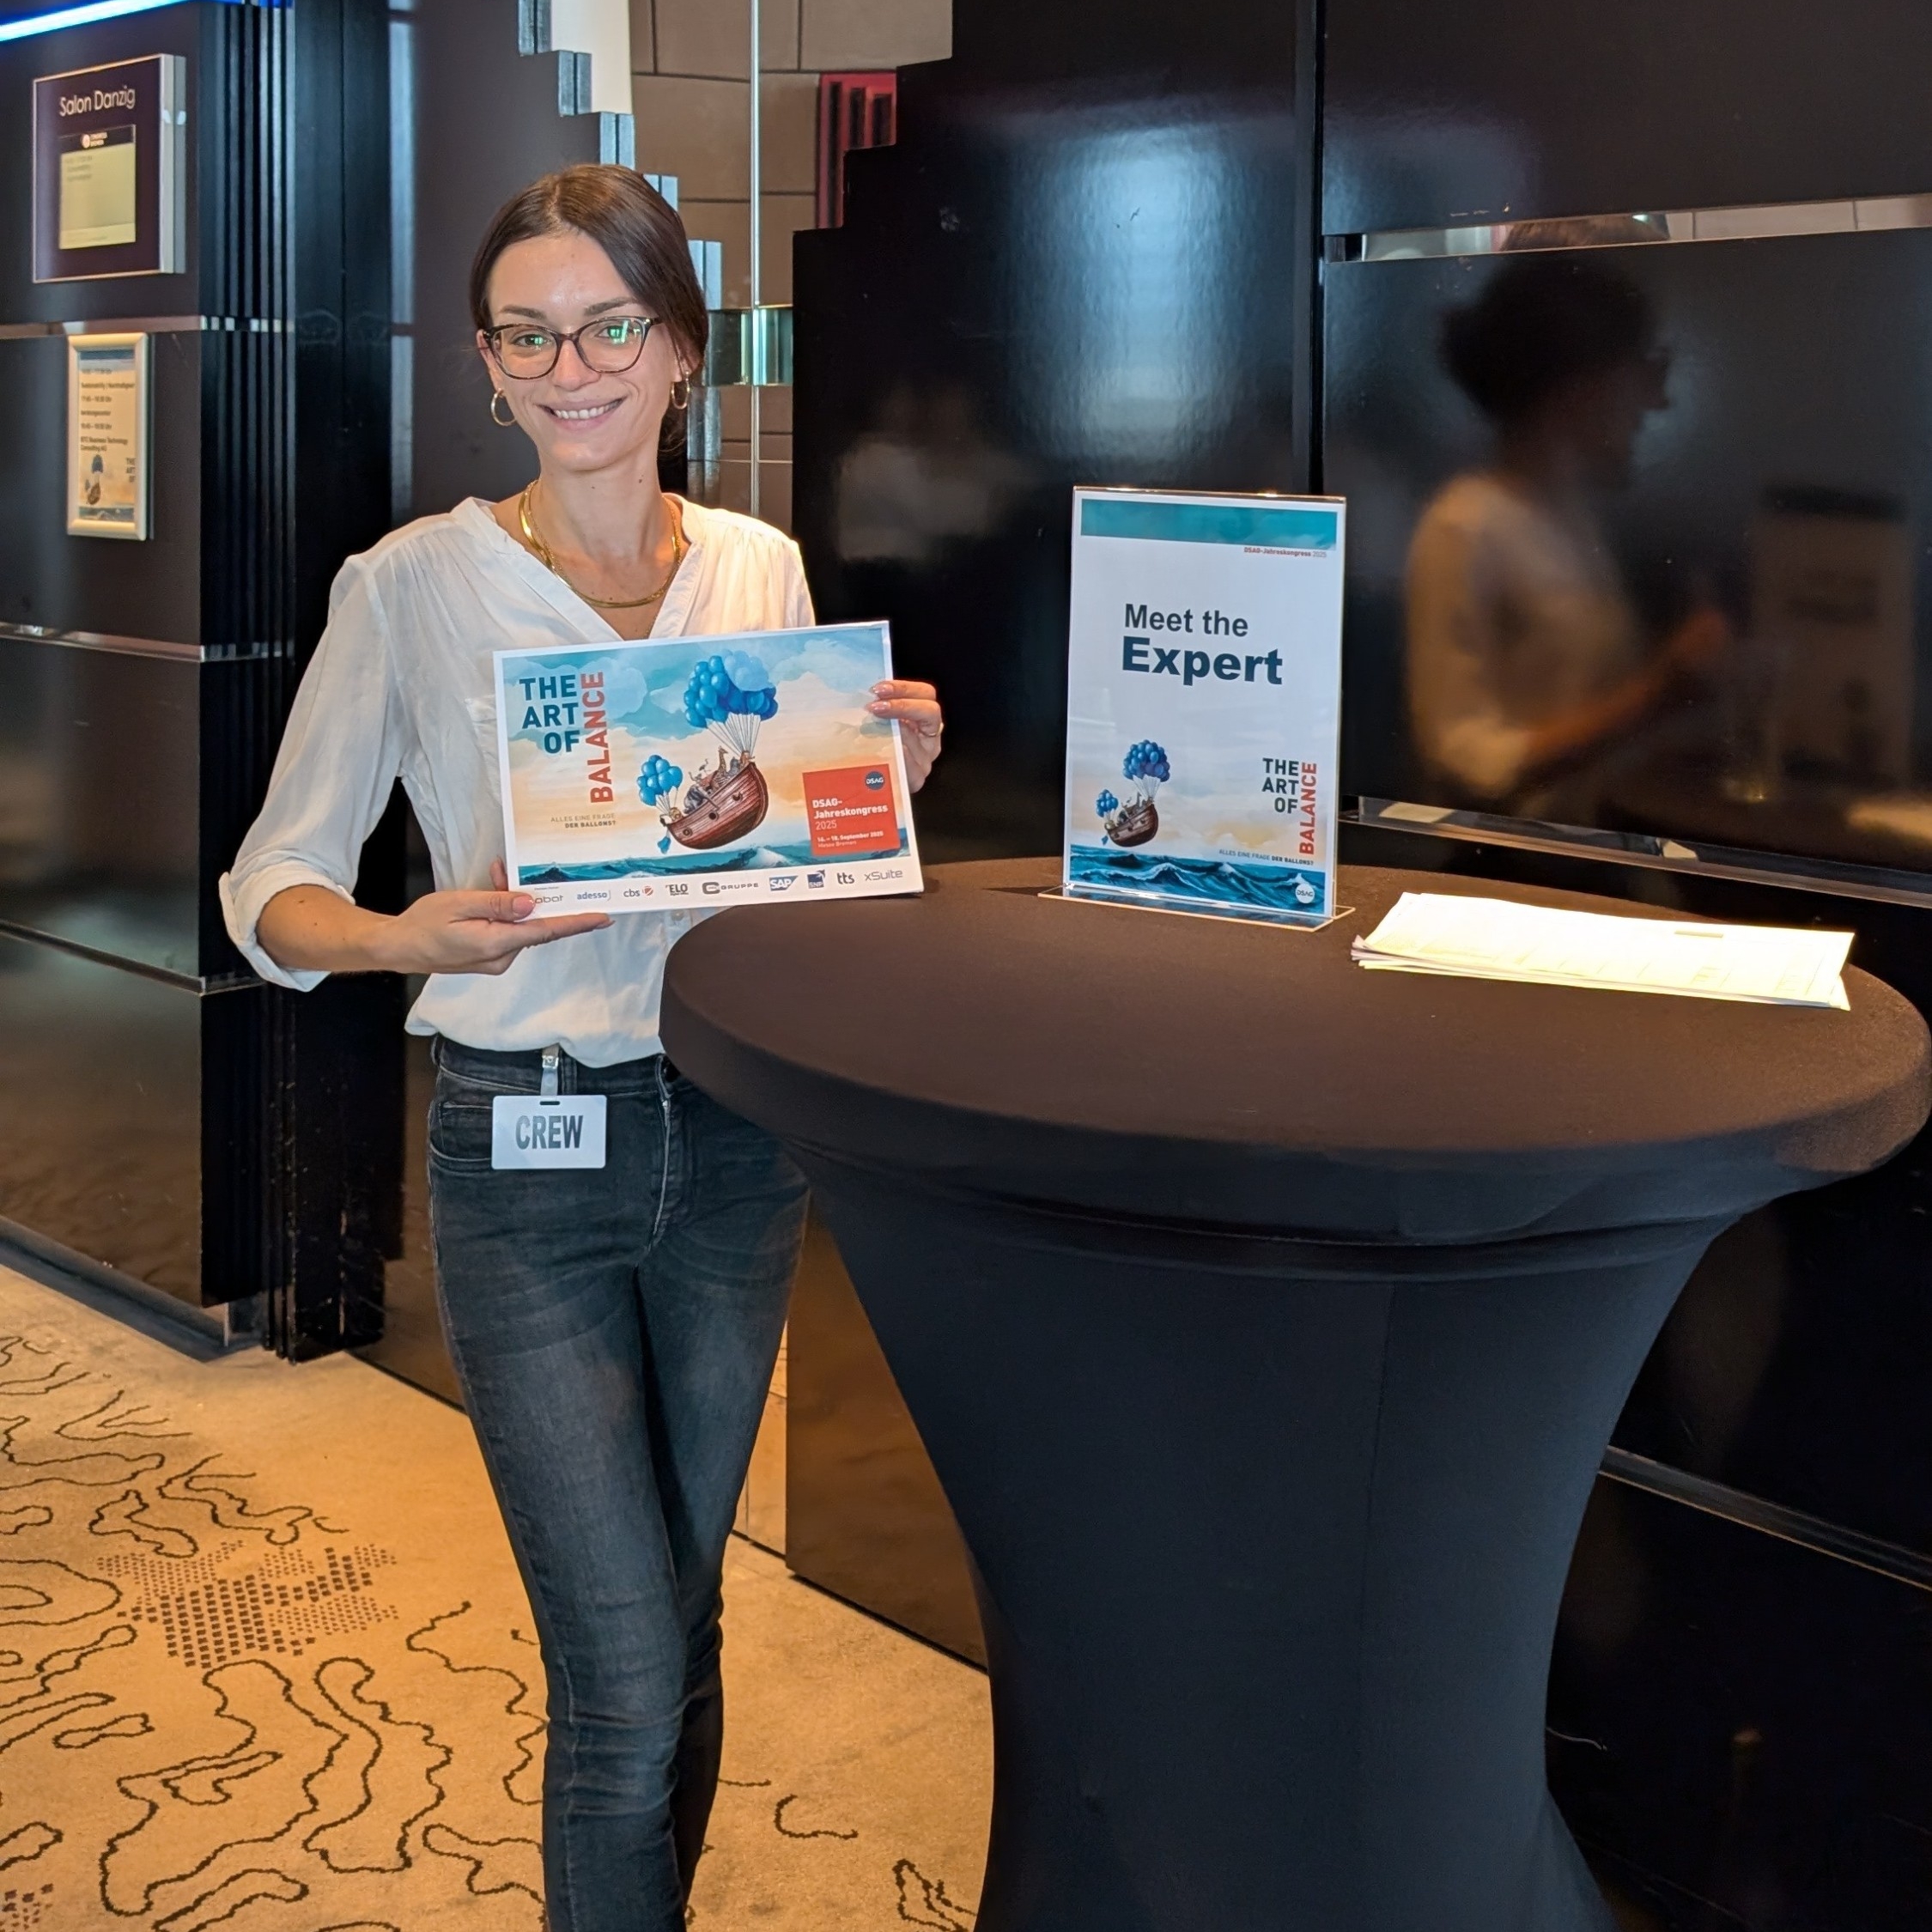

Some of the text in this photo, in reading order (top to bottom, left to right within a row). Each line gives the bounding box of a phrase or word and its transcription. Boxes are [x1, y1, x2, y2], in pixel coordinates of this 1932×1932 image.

[59, 84, 136, 117] Salon Danzig
[1124, 603, 1249, 637] Meet the
[1122, 635, 1284, 686] Expert
[519, 674, 578, 701] THE
[522, 702, 579, 729] ART
[544, 730, 581, 754] OF
[580, 671, 614, 804] BALANCE
[1262, 757, 1299, 776] THE
[1261, 776, 1299, 795] ART
[811, 798, 843, 809] DSAG-
[1274, 797, 1298, 814] OF
[1299, 762, 1317, 855] BALANCE
[814, 805, 889, 819] Jahreskongress
[815, 819, 837, 831] 2025
[840, 831, 870, 841] September
[1285, 856, 1314, 866] BALLONS?
[837, 872, 855, 884] tts
[864, 870, 903, 881] xSuite
[669, 884, 689, 894] ELO
[720, 882, 759, 890] GRUPPE
[770, 878, 793, 890] SAP
[577, 890, 608, 901] adesso
[623, 888, 641, 898] cbs
[515, 1115, 584, 1150] CREW
